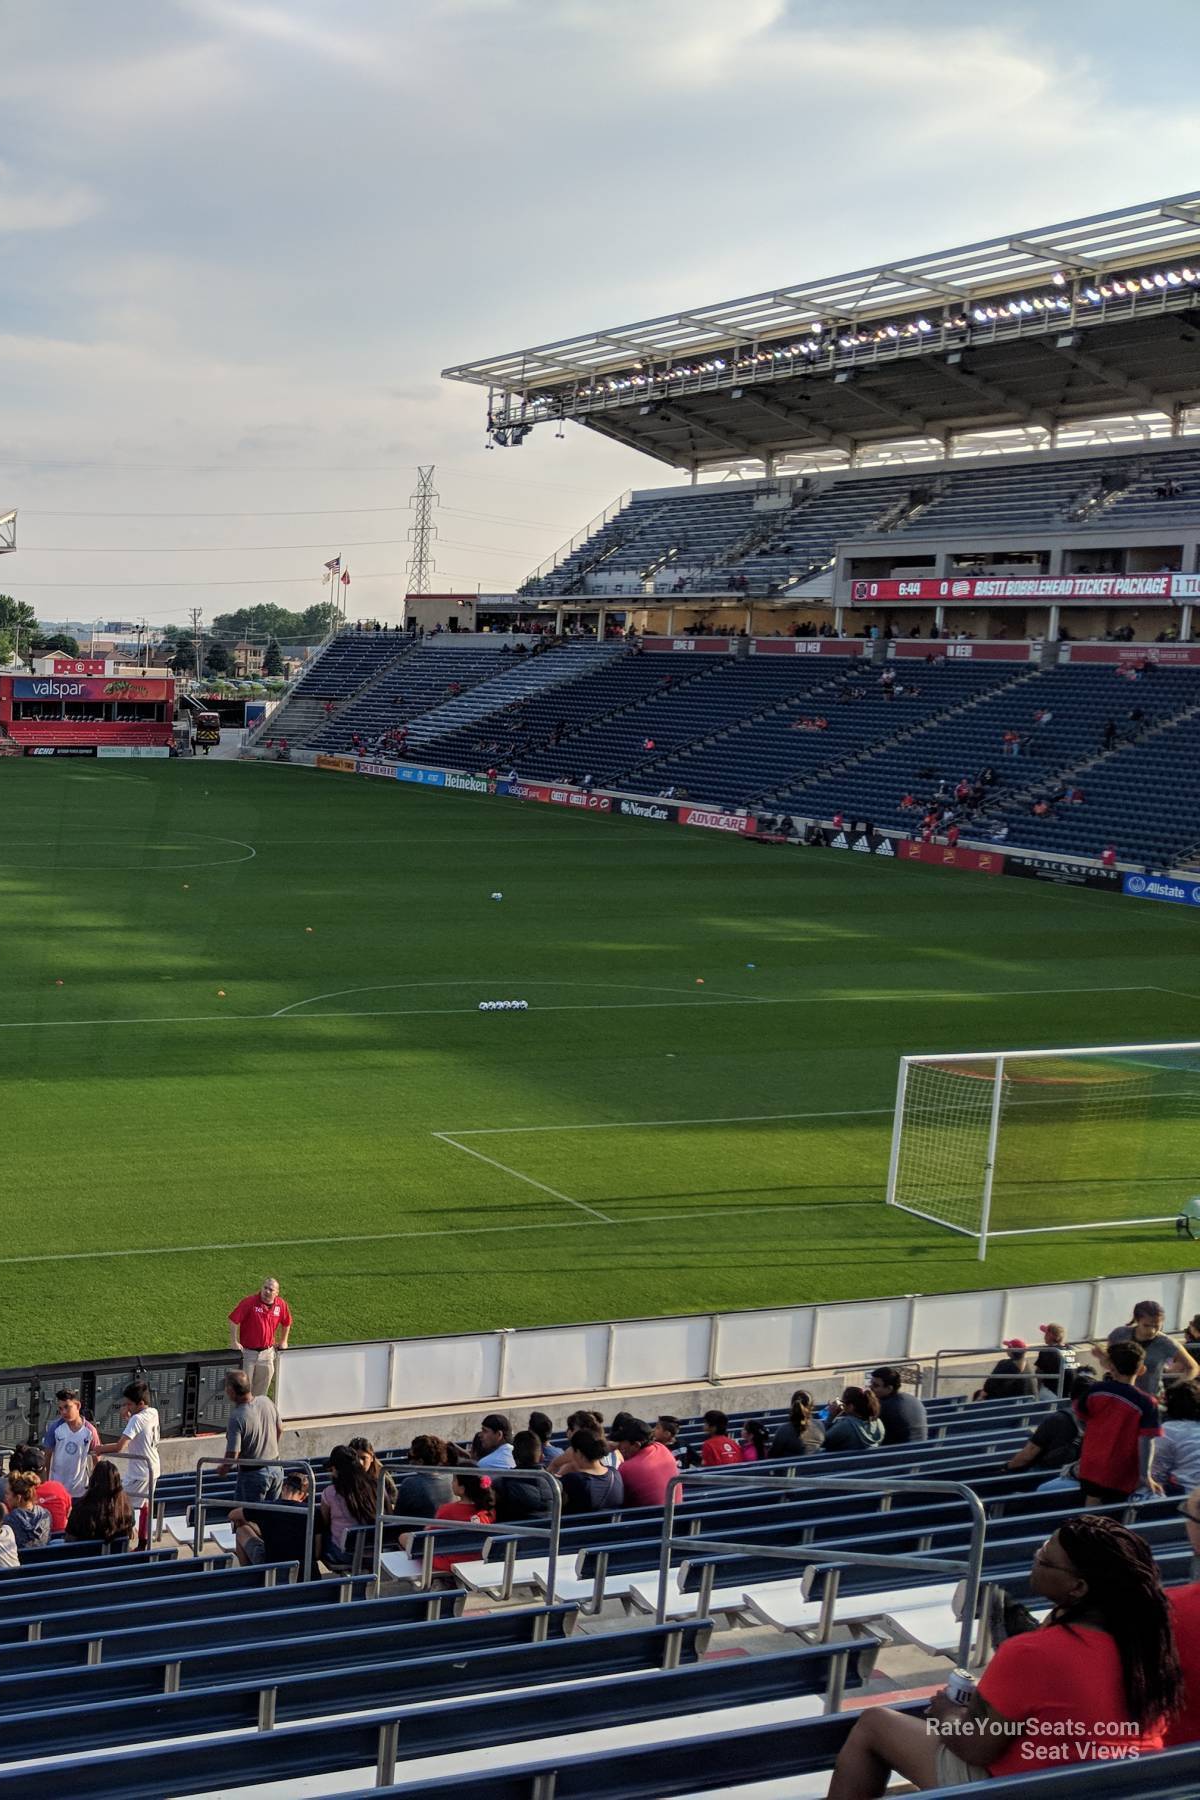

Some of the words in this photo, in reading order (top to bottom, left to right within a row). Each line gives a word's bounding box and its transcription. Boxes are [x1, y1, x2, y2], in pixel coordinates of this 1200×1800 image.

[870, 583, 878, 596] 0
[898, 582, 921, 596] 6:44
[940, 581, 948, 595] 0
[974, 580, 1006, 596] BASTI
[1006, 579, 1073, 595] BOBBLEHEAD
[1073, 578, 1115, 595] TICKET
[1114, 577, 1169, 594] PACKAGE
[32, 680, 87, 699] valspar
[34, 747, 55, 755] ECHO
[445, 773, 487, 793] Heineken
[629, 801, 669, 820] NovaCare
[687, 810, 747, 832] ADVOCARE
[1023, 857, 1118, 879] BLACKSTONE
[1145, 882, 1185, 899] Allstate
